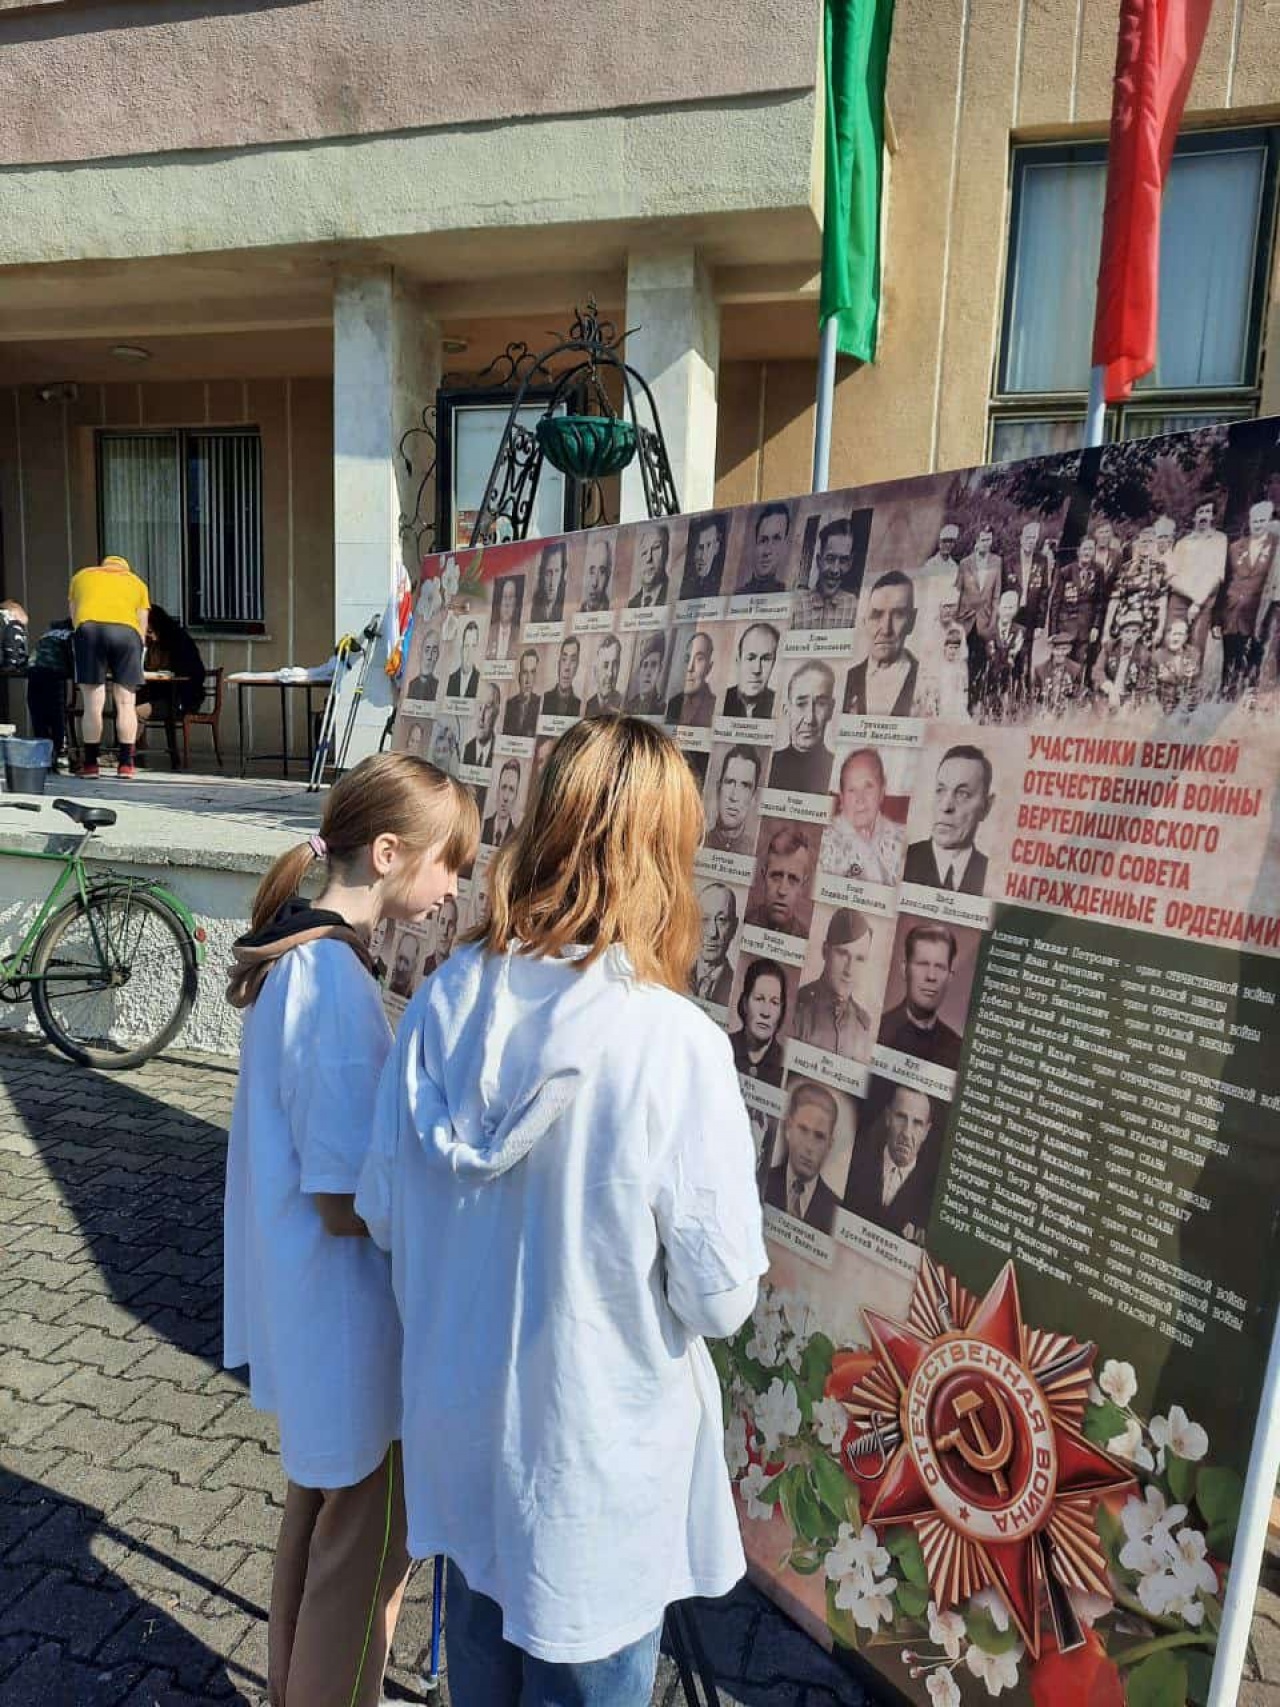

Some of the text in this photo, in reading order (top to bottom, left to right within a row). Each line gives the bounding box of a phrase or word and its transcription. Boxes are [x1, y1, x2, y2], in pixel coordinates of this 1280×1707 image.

[1028, 735, 1240, 773] УЧАСТНИКИ ВЕЛИКОЙ
[1024, 771, 1261, 816] ОТЕЧЕСТВЕННОЙ ВОЙНЫ
[1018, 804, 1220, 853] ВЕРТЕЛИШКОВСКОГО
[1011, 838, 1190, 890] СЕЛЬСКОГО СОВЕТА
[1005, 872, 1280, 948] НАГРАЖДЕННЫЕ ОРДЕНАМИ
[1243, 987, 1275, 1004] ВОЙНЫ
[1229, 1024, 1261, 1041] ВОЙНЫ
[1195, 1095, 1224, 1112] ВОЙНЫ
[1216, 1287, 1247, 1310] ВОЙНЫ
[1176, 1310, 1205, 1332] ВОЙНЫ
[1212, 1307, 1243, 1331] ВОЙНЫ
[912, 1343, 1047, 1485] ОТЕЧЕСТВЕННАЯ
